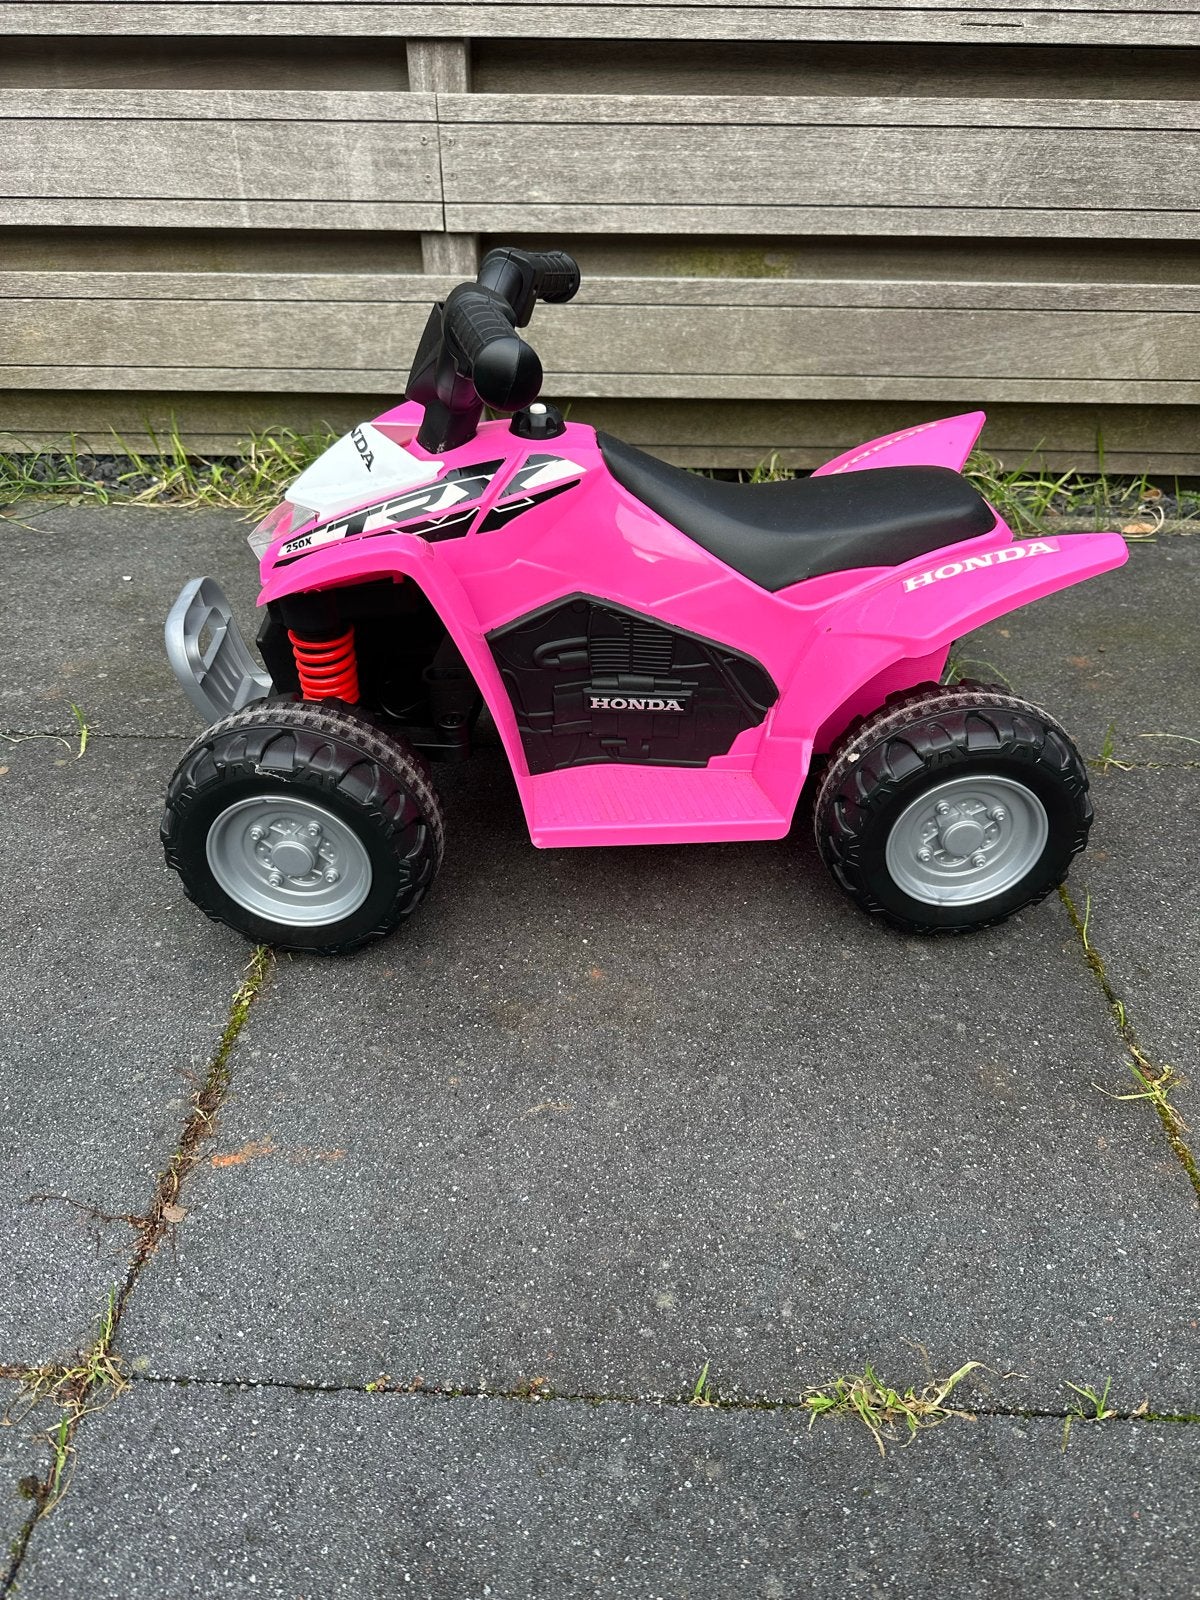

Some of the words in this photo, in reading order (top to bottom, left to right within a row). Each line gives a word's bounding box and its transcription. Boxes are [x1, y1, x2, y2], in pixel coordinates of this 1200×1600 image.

[286, 536, 312, 553] 250X
[904, 541, 1056, 593] HONDA
[590, 697, 685, 711] HONDA
